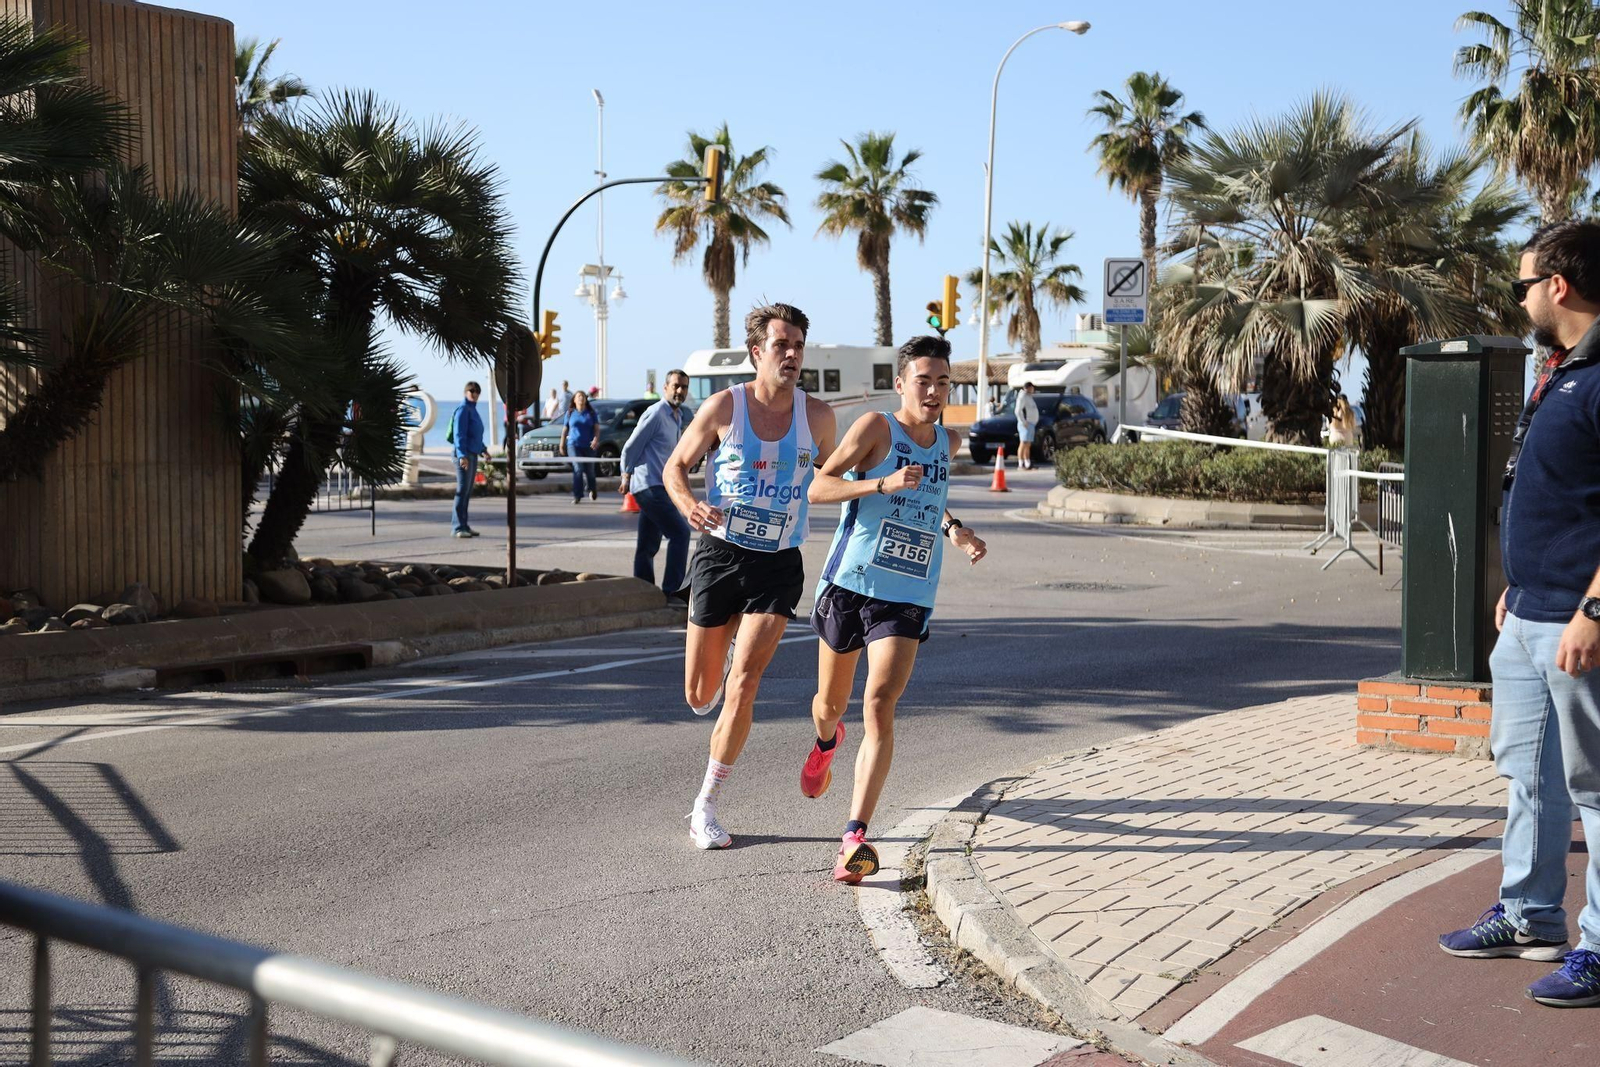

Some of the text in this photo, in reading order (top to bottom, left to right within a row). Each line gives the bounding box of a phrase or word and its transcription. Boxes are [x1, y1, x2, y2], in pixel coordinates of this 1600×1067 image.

[740, 507, 758, 516] Carrera
[744, 521, 768, 537] 26
[892, 527, 910, 537] Carrera
[890, 532, 912, 543] Solidaria
[882, 539, 928, 563] 2156
